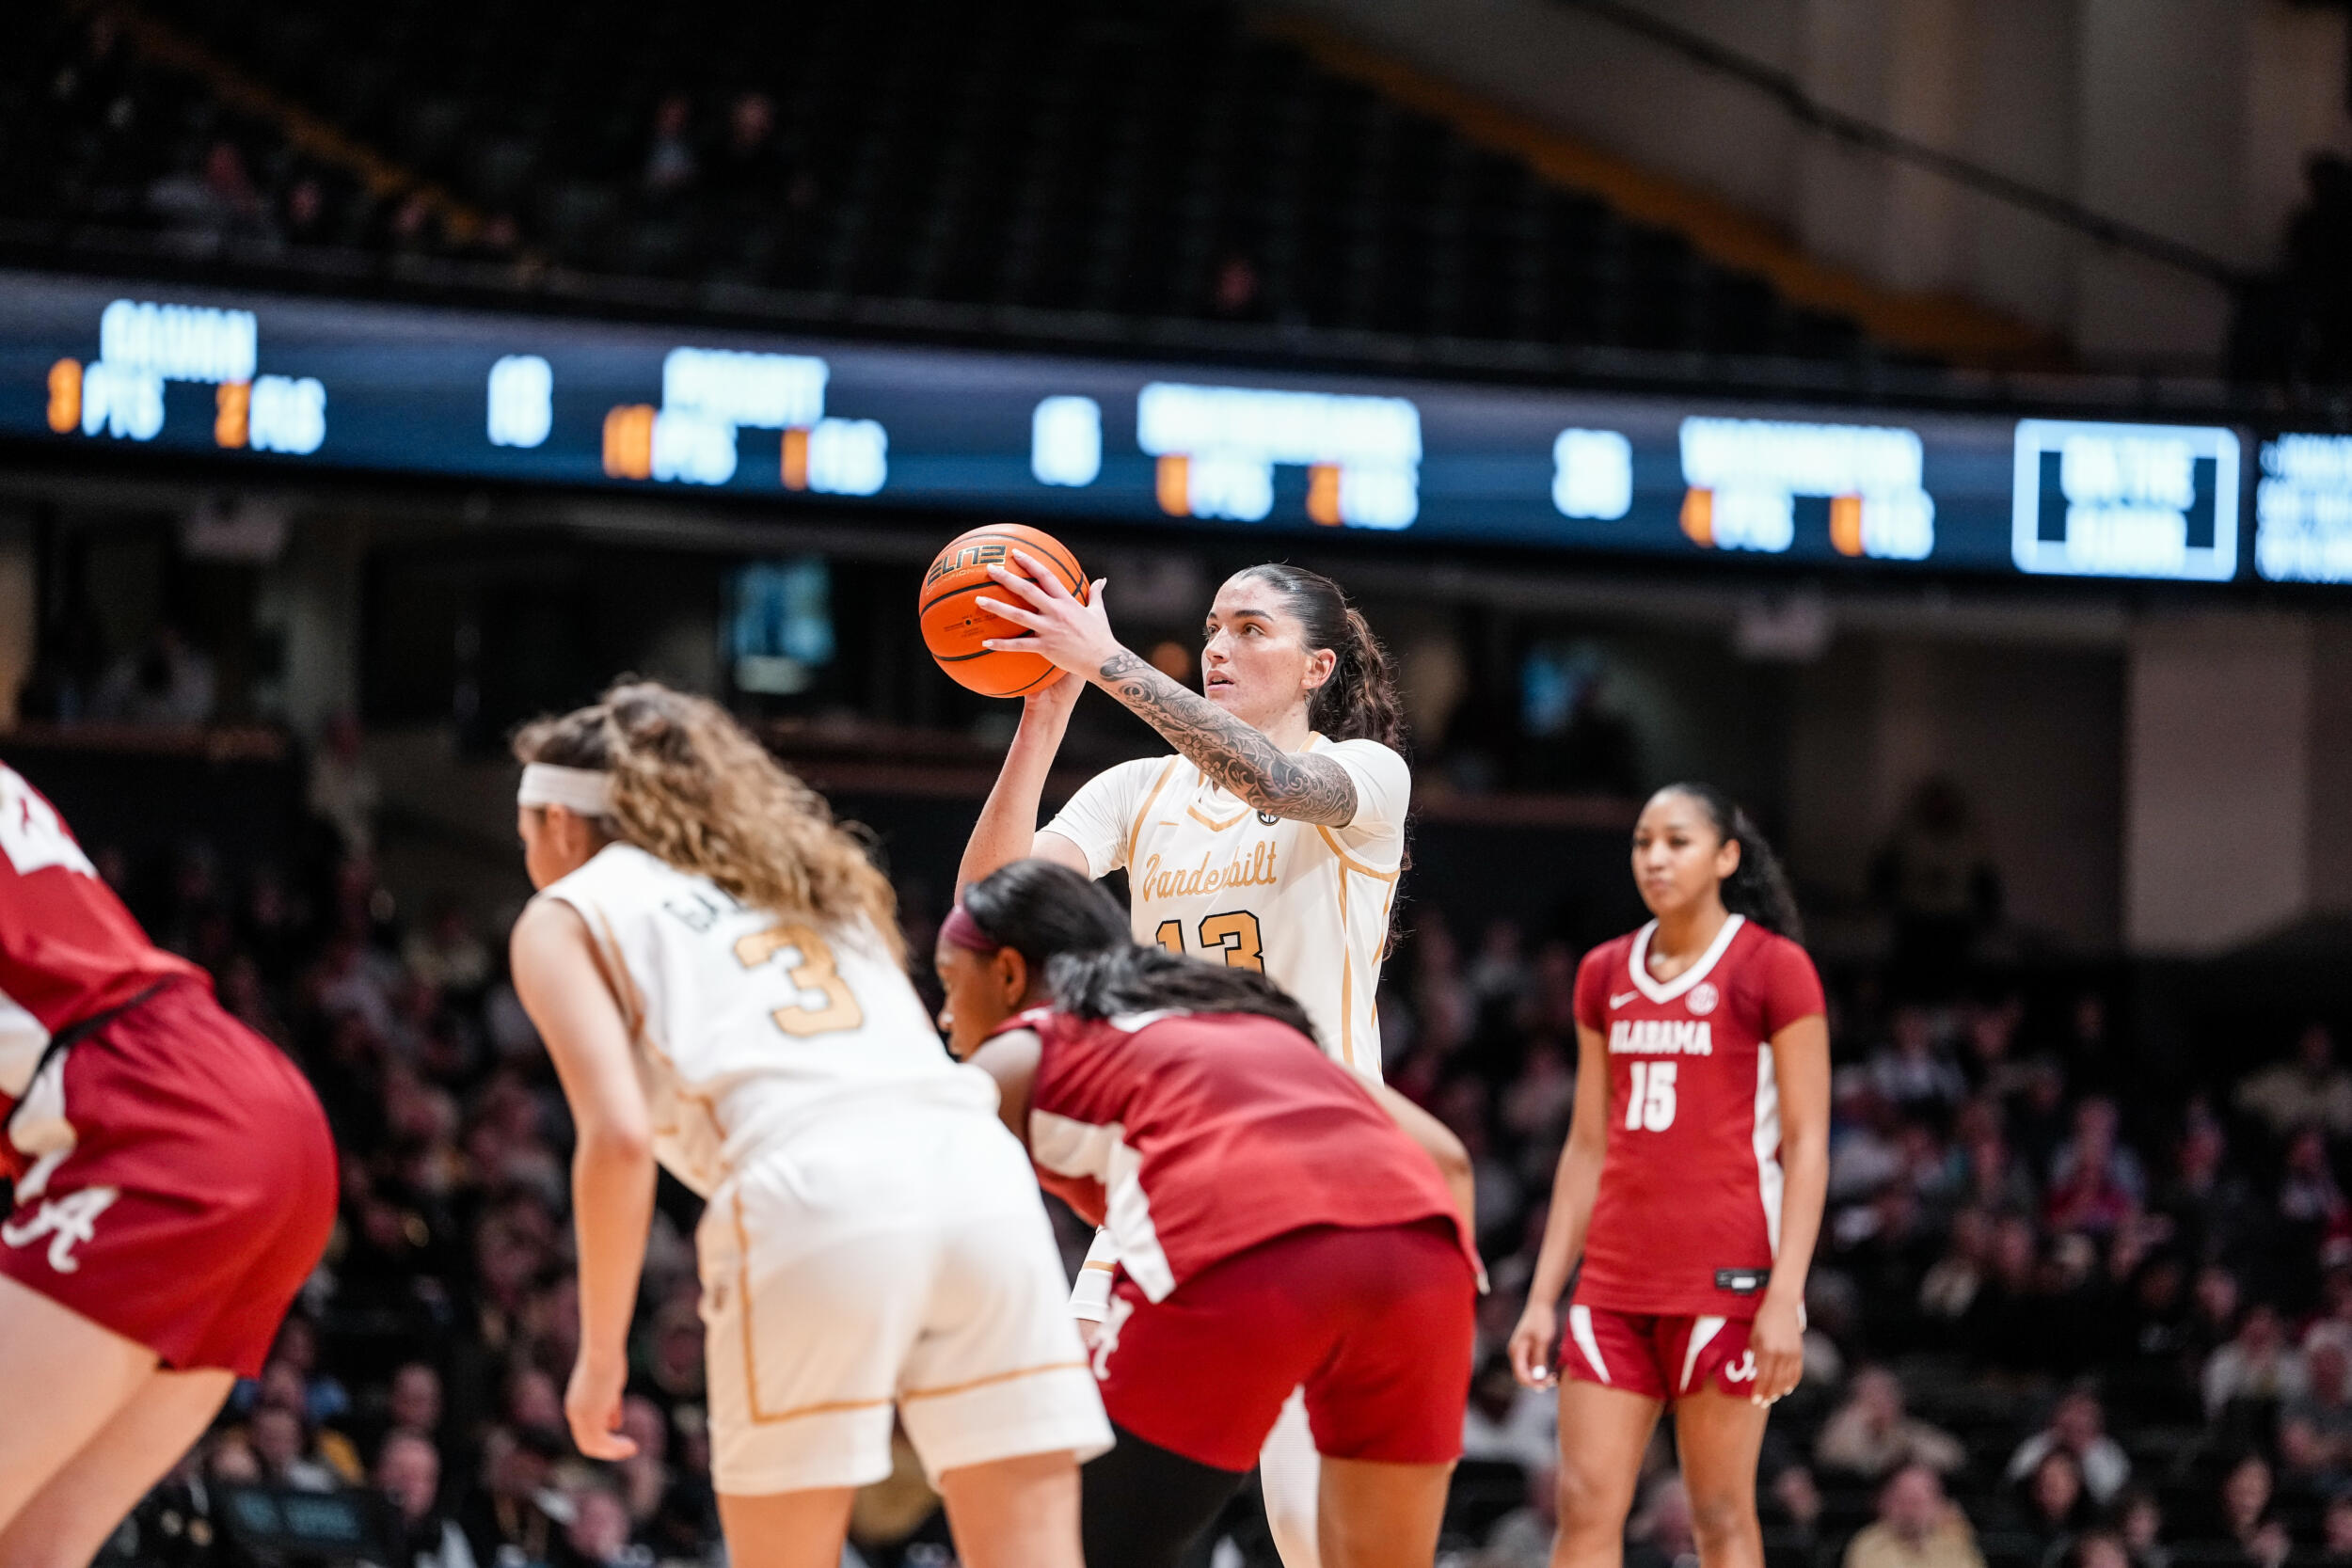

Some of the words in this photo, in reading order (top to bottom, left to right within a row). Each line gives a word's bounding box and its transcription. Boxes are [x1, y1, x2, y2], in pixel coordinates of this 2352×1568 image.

[927, 545, 1008, 586] ELITE
[1142, 840, 1278, 903] Vanderbilt
[734, 924, 864, 1038] 3
[1609, 1020, 1713, 1056] ALABAMA
[1625, 1061, 1677, 1132] 15
